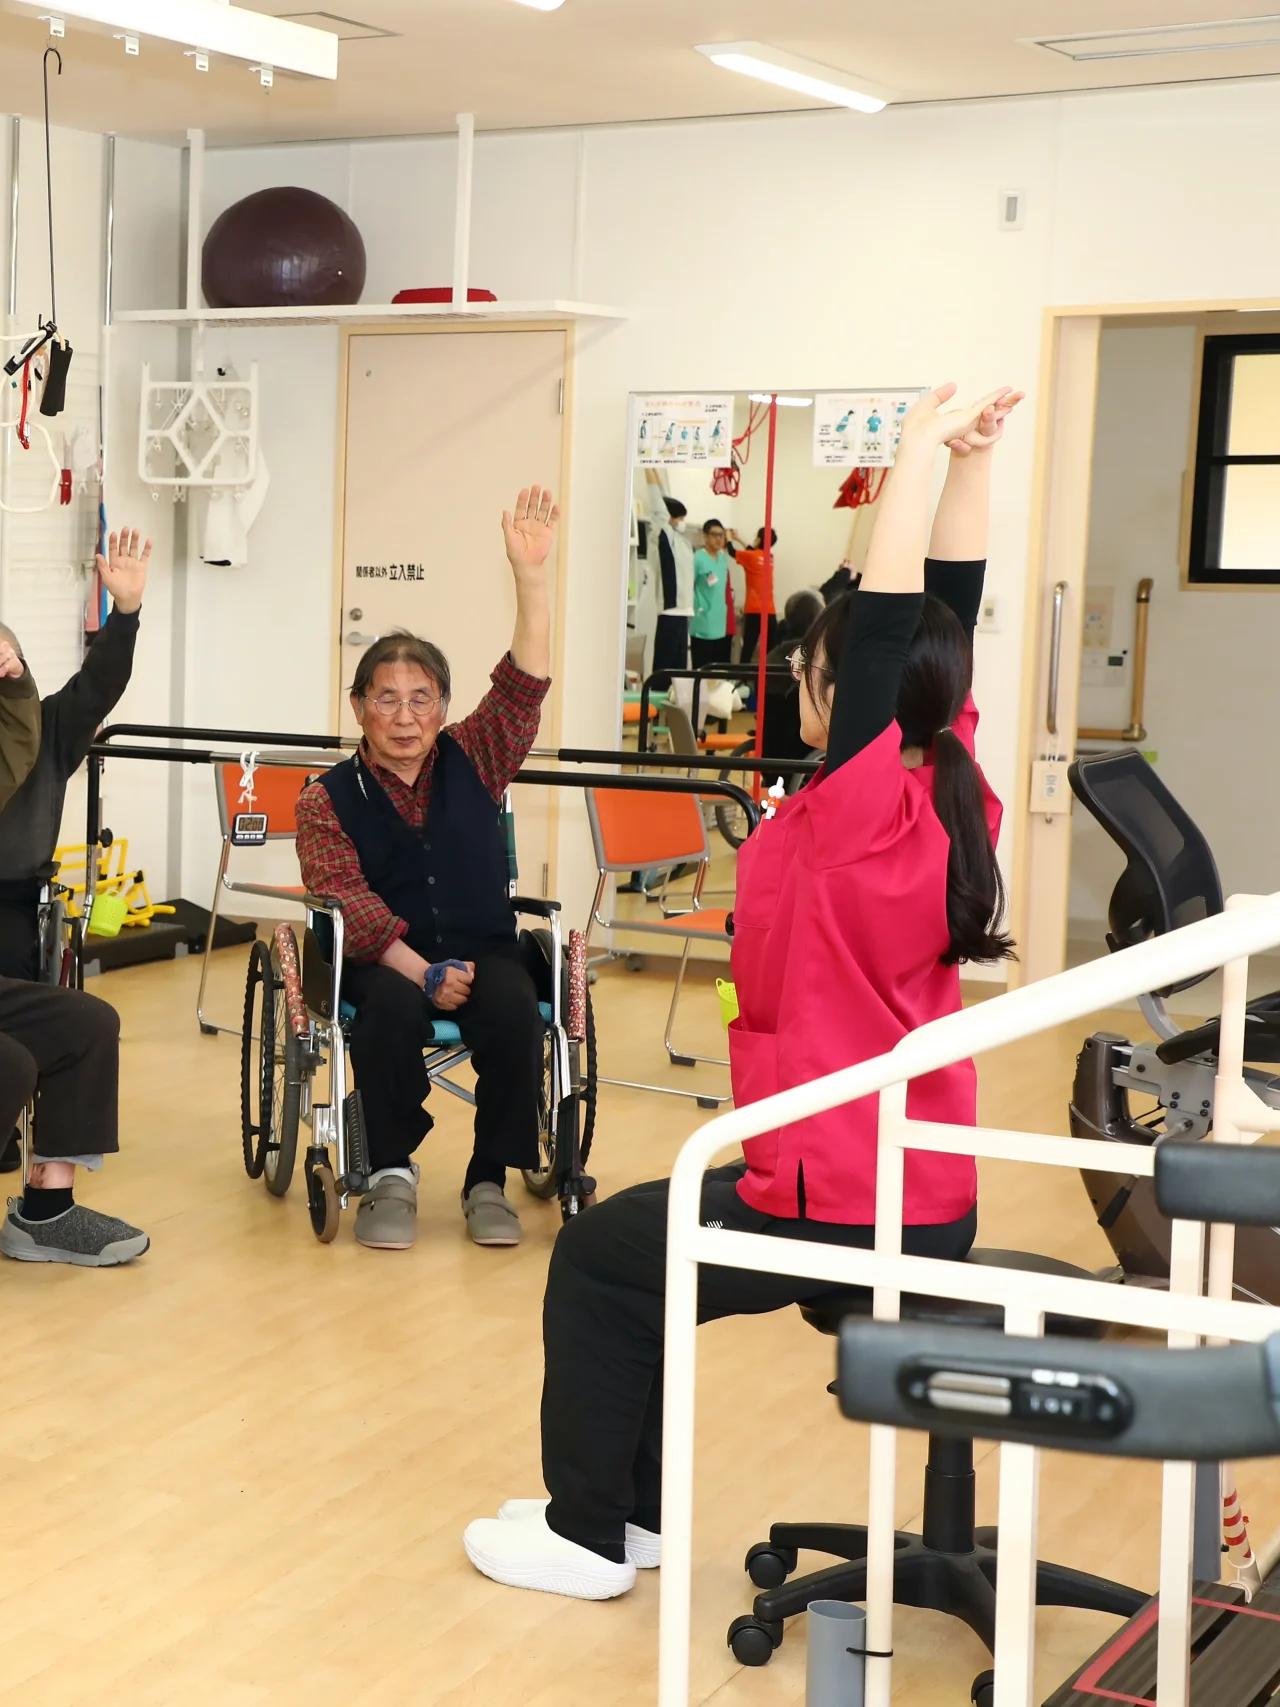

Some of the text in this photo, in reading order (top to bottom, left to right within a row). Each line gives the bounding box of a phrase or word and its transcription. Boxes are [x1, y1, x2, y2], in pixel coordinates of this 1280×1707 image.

[356, 563, 425, 581] 関係者以外 立入禁止
